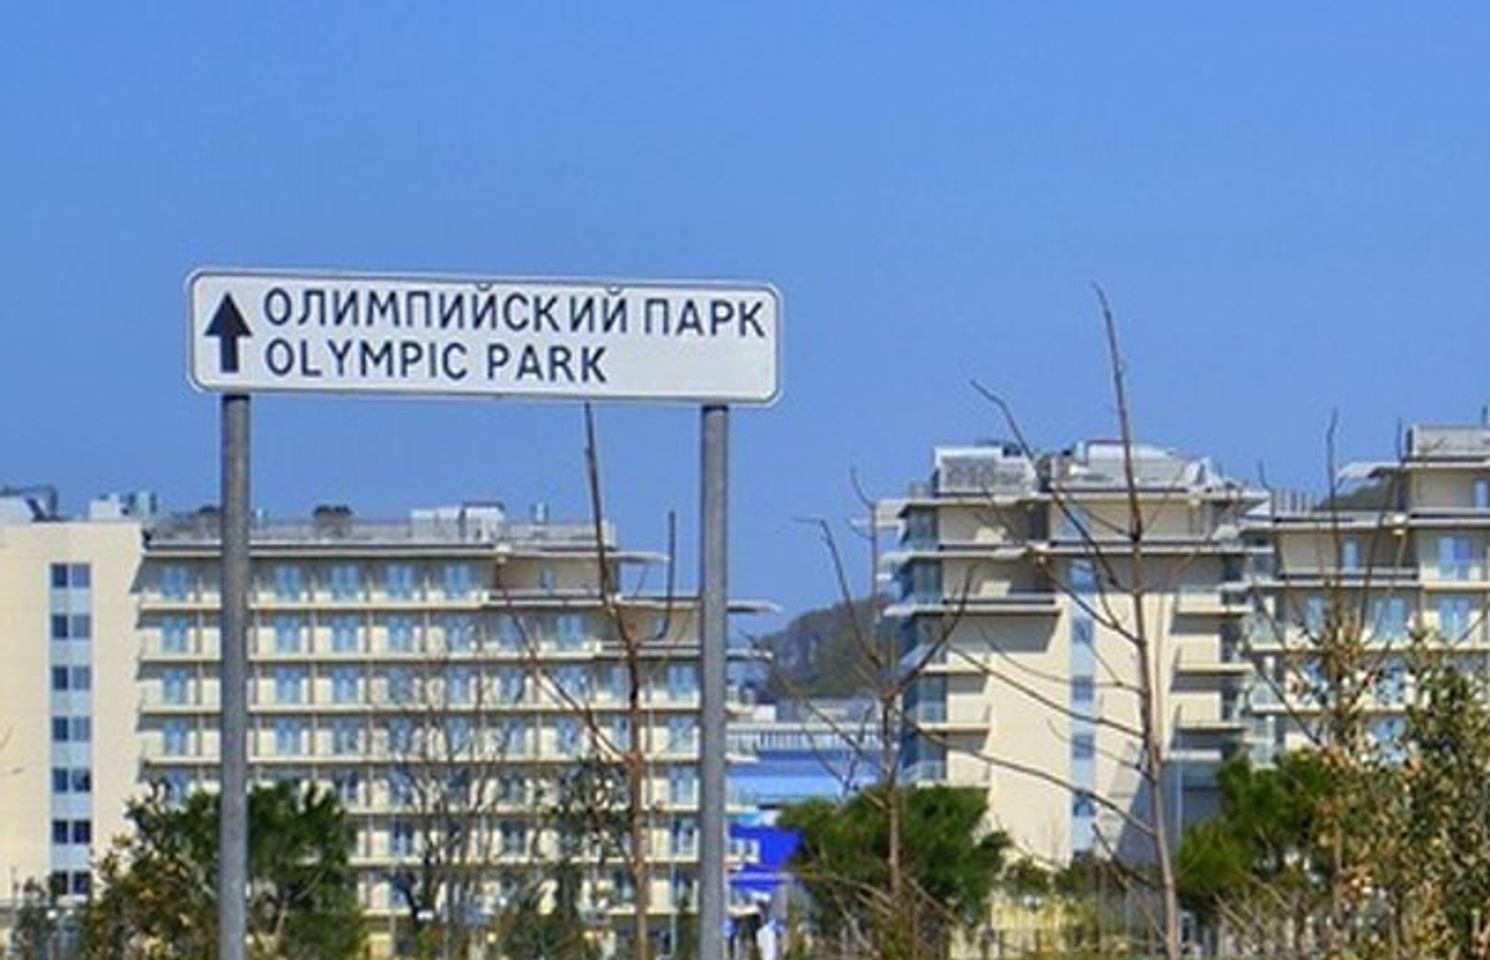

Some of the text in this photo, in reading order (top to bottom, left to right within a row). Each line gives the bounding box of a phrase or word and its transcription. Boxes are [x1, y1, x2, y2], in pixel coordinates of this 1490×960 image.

[262, 283, 766, 339] ОЛИМПИЙСКИЙ ПАРК
[264, 336, 608, 385] OLYMPIC PARK
